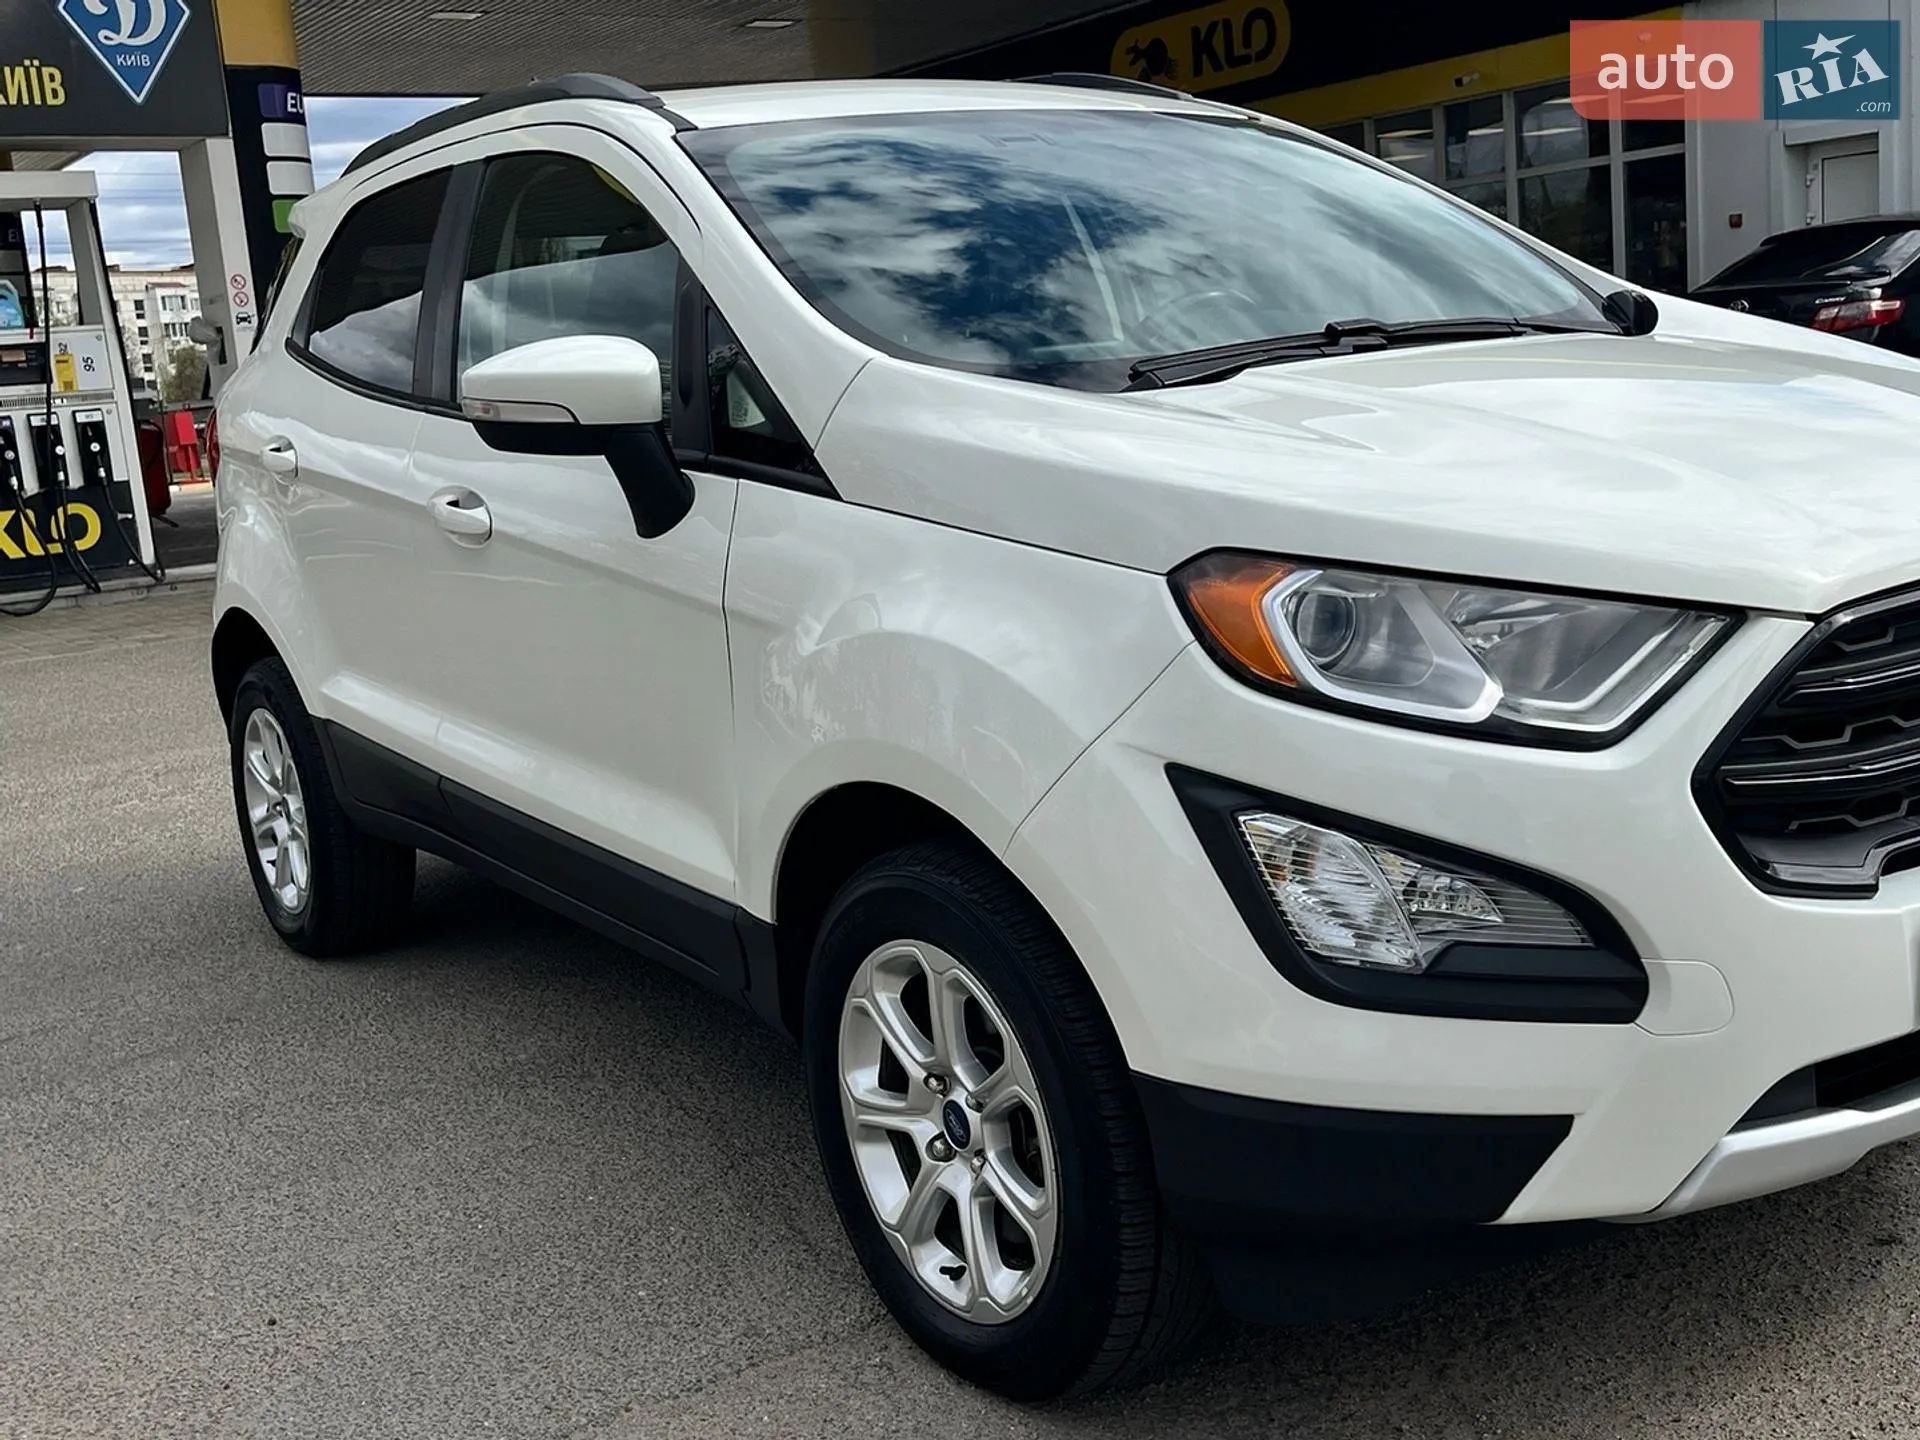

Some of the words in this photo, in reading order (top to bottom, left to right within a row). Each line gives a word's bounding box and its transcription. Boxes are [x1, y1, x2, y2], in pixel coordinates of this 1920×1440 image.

[1190, 7, 1277, 78] KLO
[116, 51, 151, 67] КИЇВ
[0, 59, 66, 105] ИЇВ
[82, 356, 95, 372] 95
